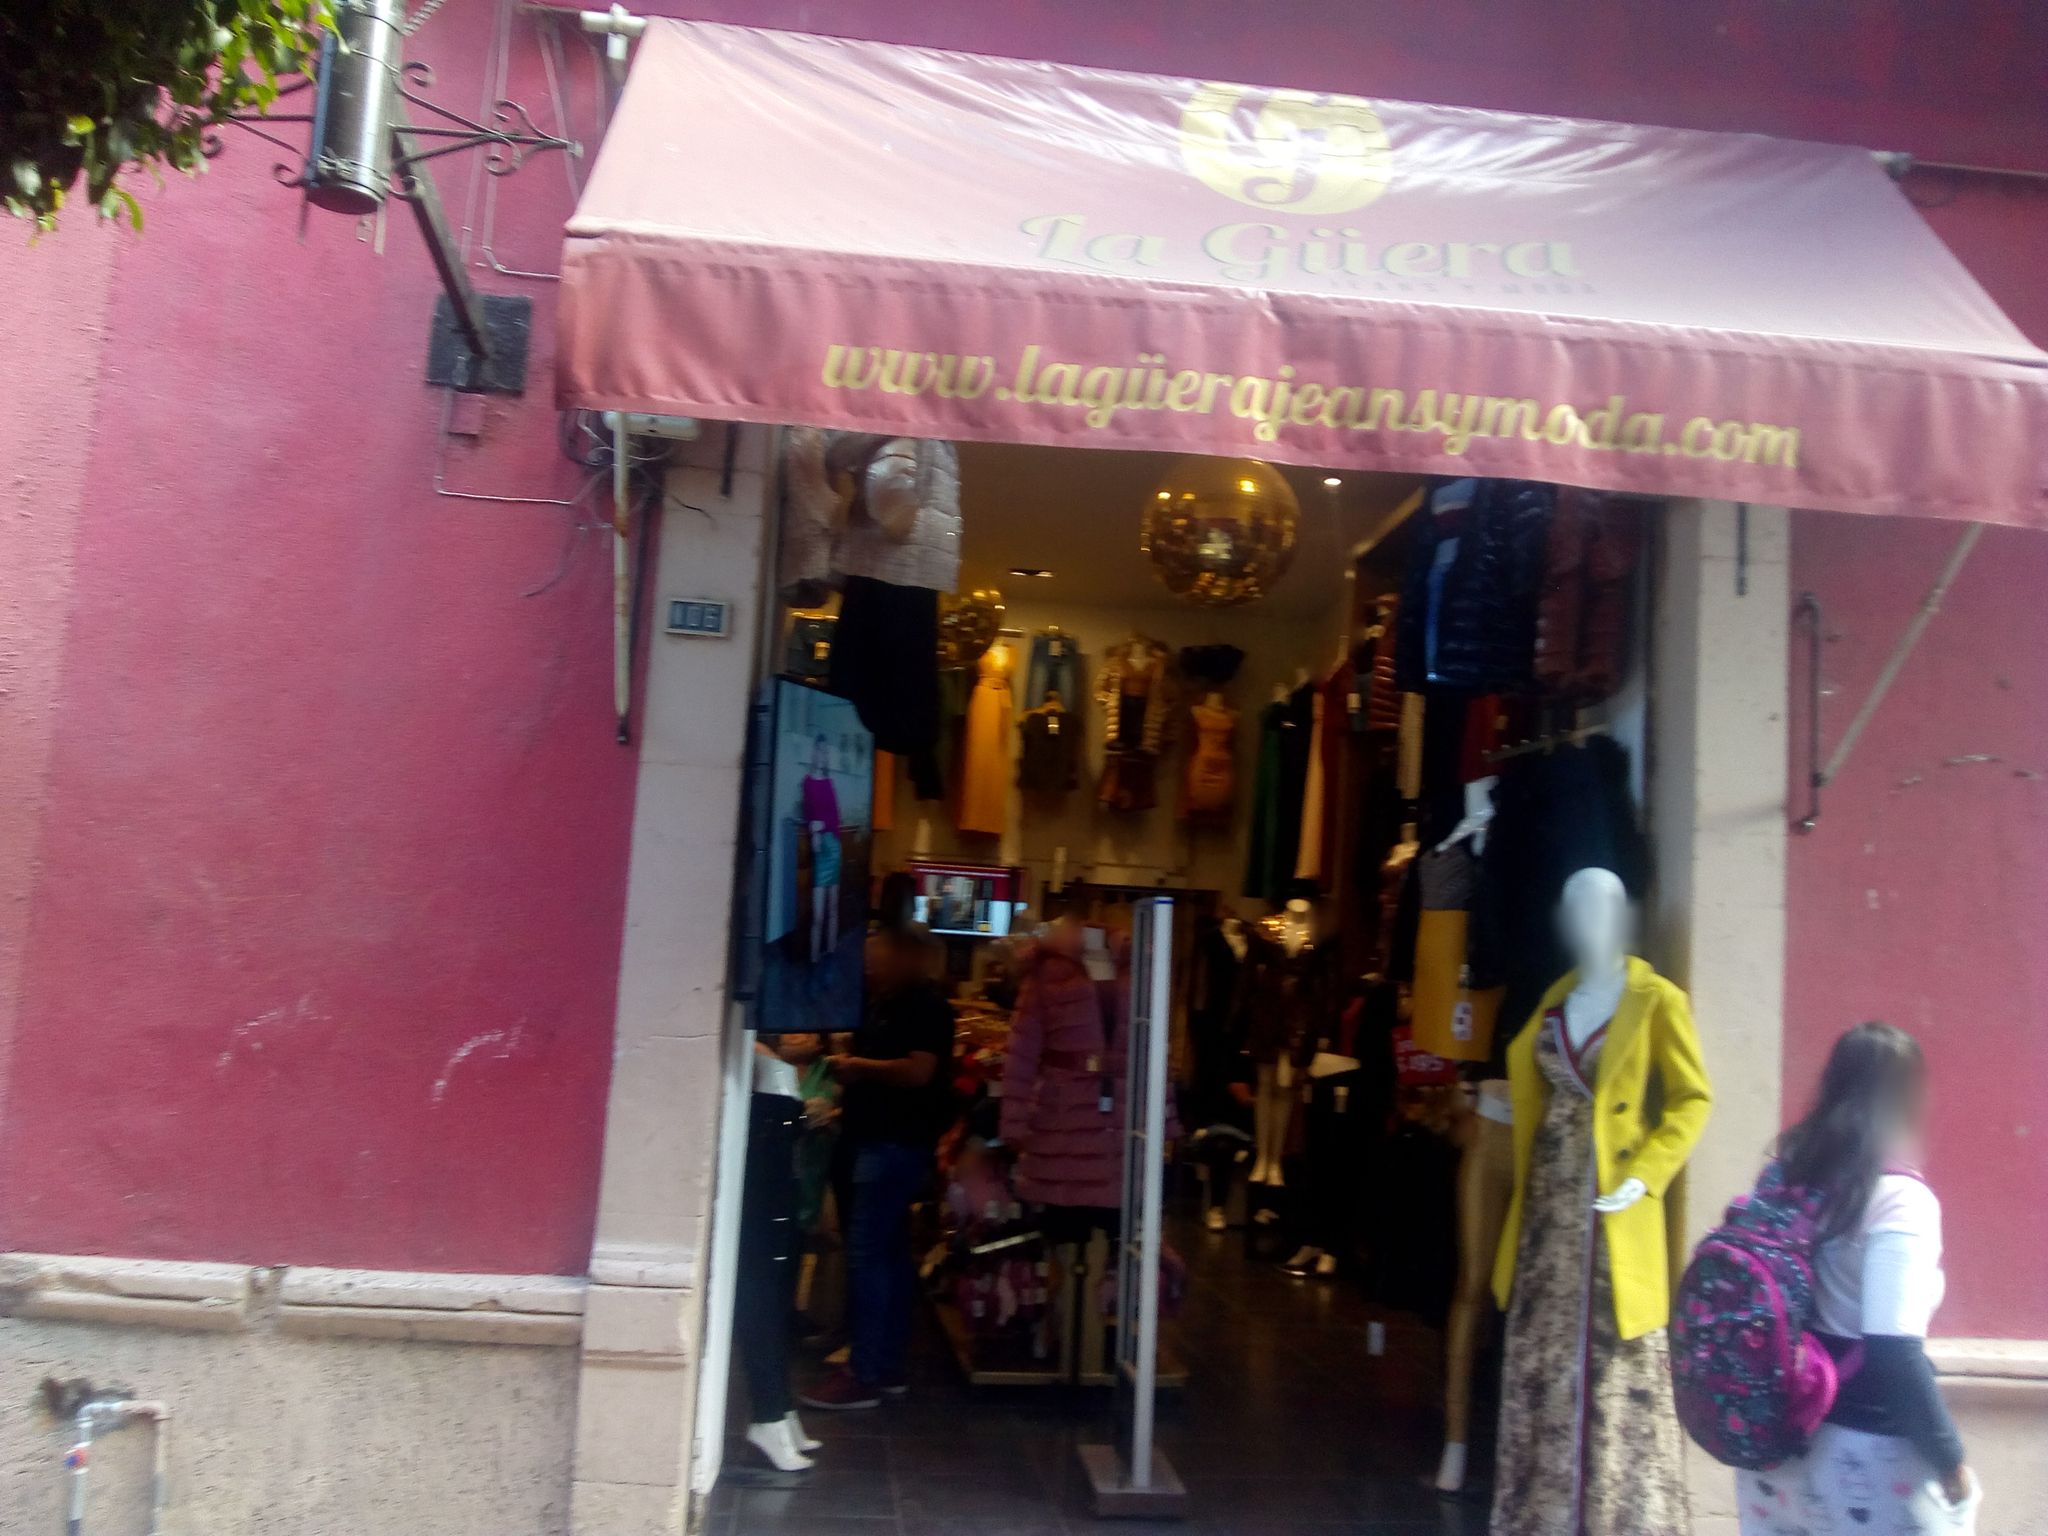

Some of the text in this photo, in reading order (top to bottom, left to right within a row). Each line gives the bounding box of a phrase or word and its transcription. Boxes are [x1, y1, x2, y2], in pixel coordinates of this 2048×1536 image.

[1019, 212, 1586, 280] La Güera
[822, 343, 1801, 469] www.lagüerajeansymoda.com
